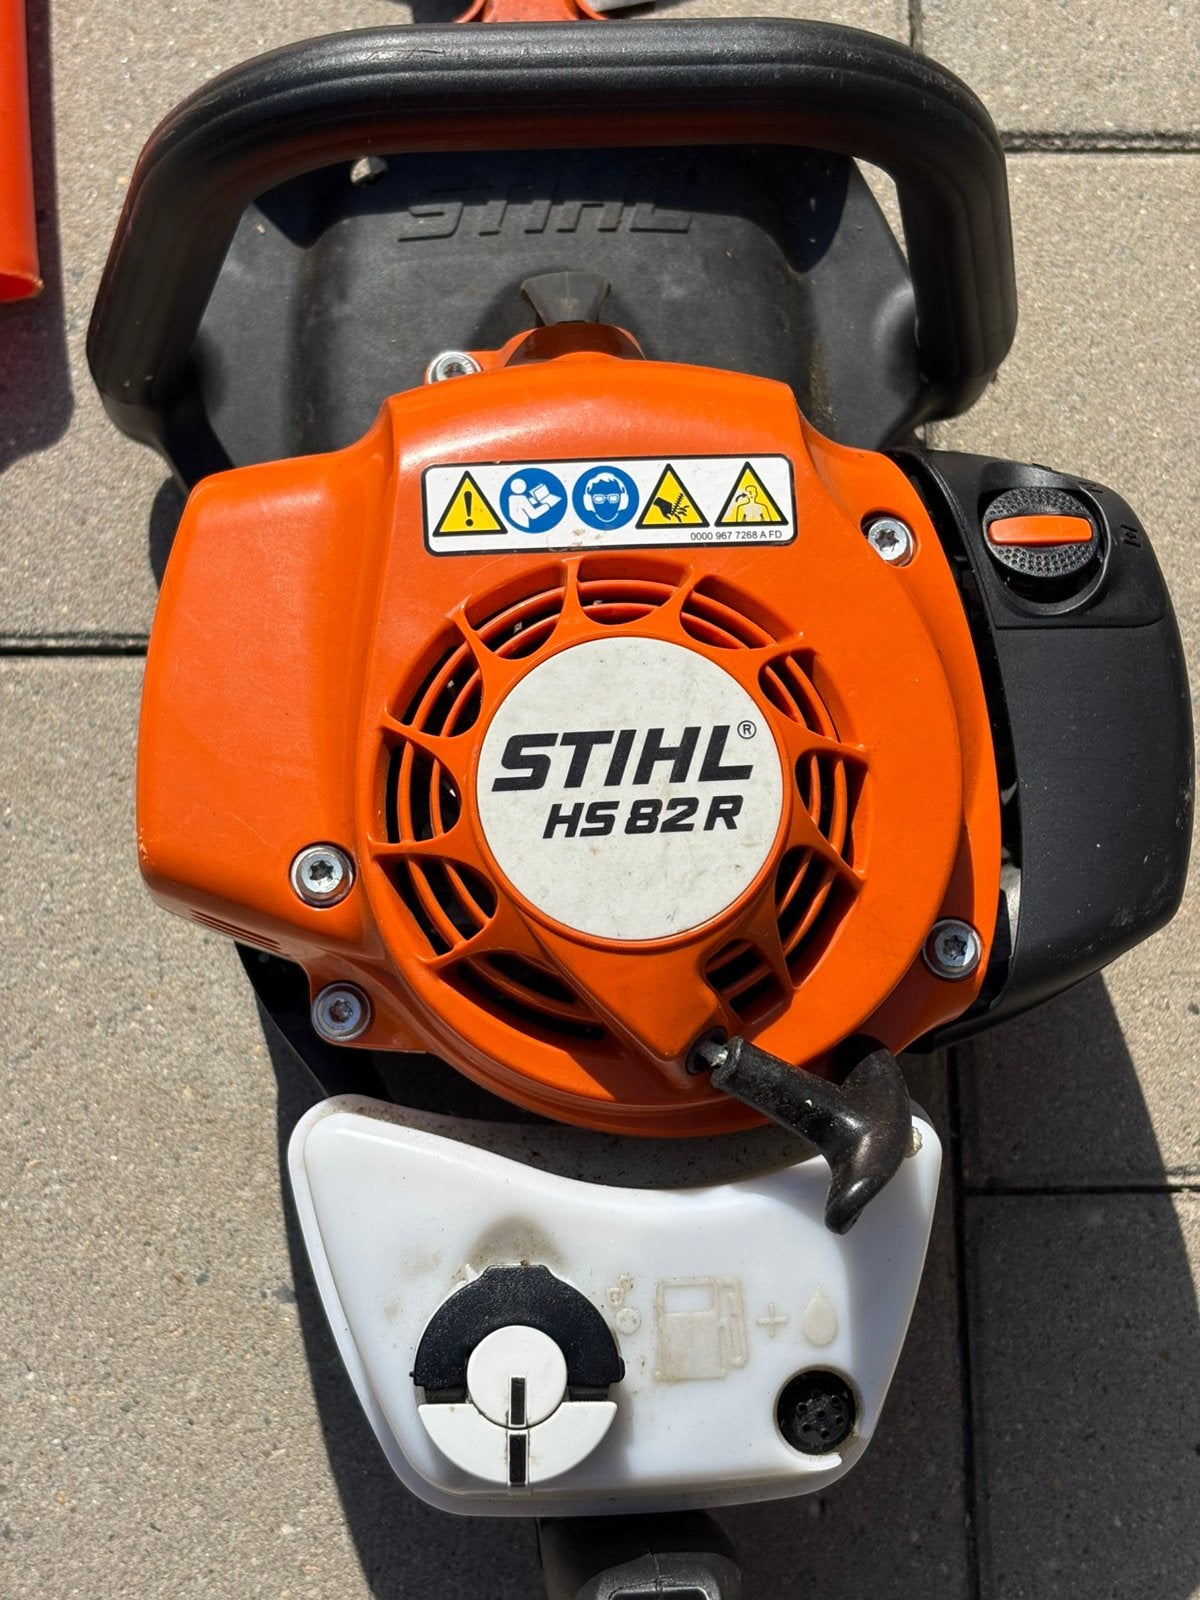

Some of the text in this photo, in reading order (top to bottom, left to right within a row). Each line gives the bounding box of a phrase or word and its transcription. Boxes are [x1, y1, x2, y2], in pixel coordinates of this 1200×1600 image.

[397, 171, 692, 242] STIHL
[690, 530, 782, 540] 0000 967 7268 A FD
[542, 795, 744, 839] HS 82 R
